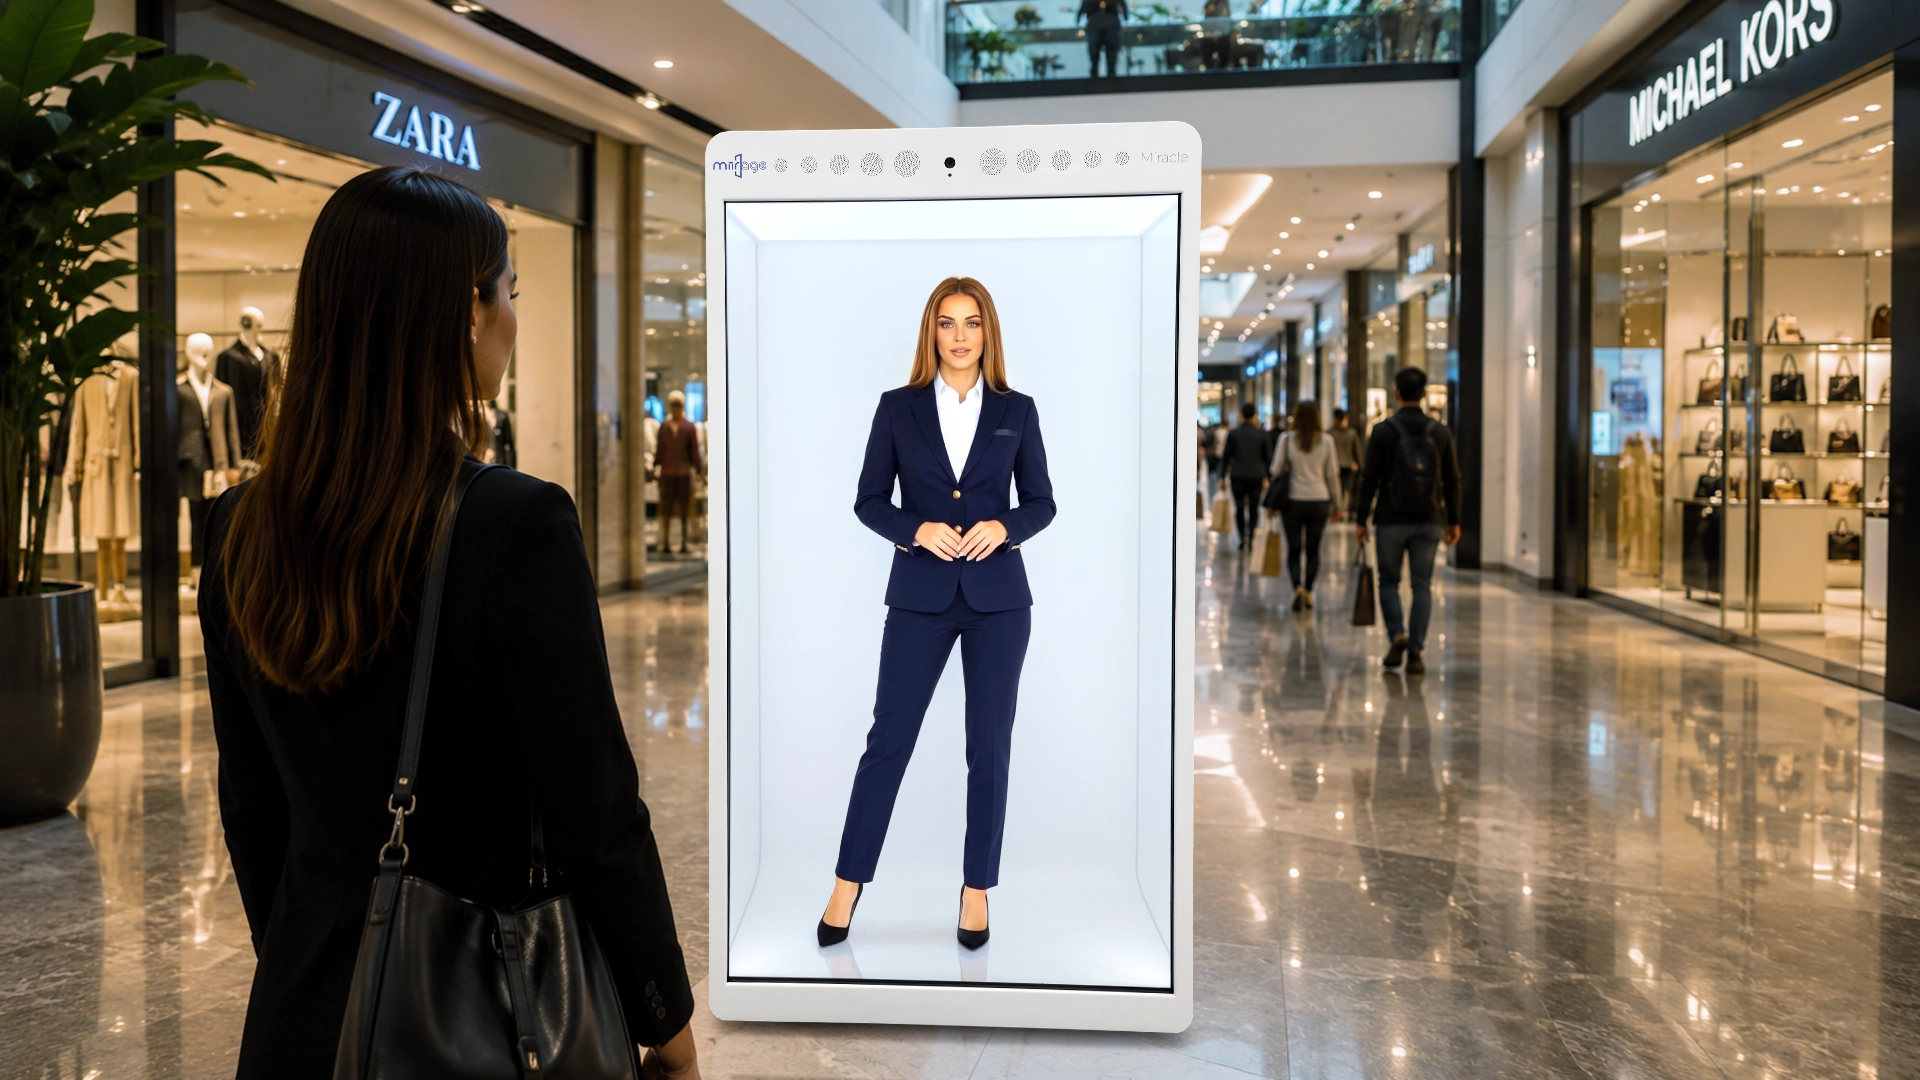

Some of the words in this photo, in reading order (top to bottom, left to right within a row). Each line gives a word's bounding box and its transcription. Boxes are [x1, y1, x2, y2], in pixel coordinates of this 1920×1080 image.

[1629, 37, 1733, 147] MICHAEL
[1740, 0, 1833, 83] KORS
[372, 90, 481, 171] ZARA
[1140, 151, 1189, 163] Miracle
